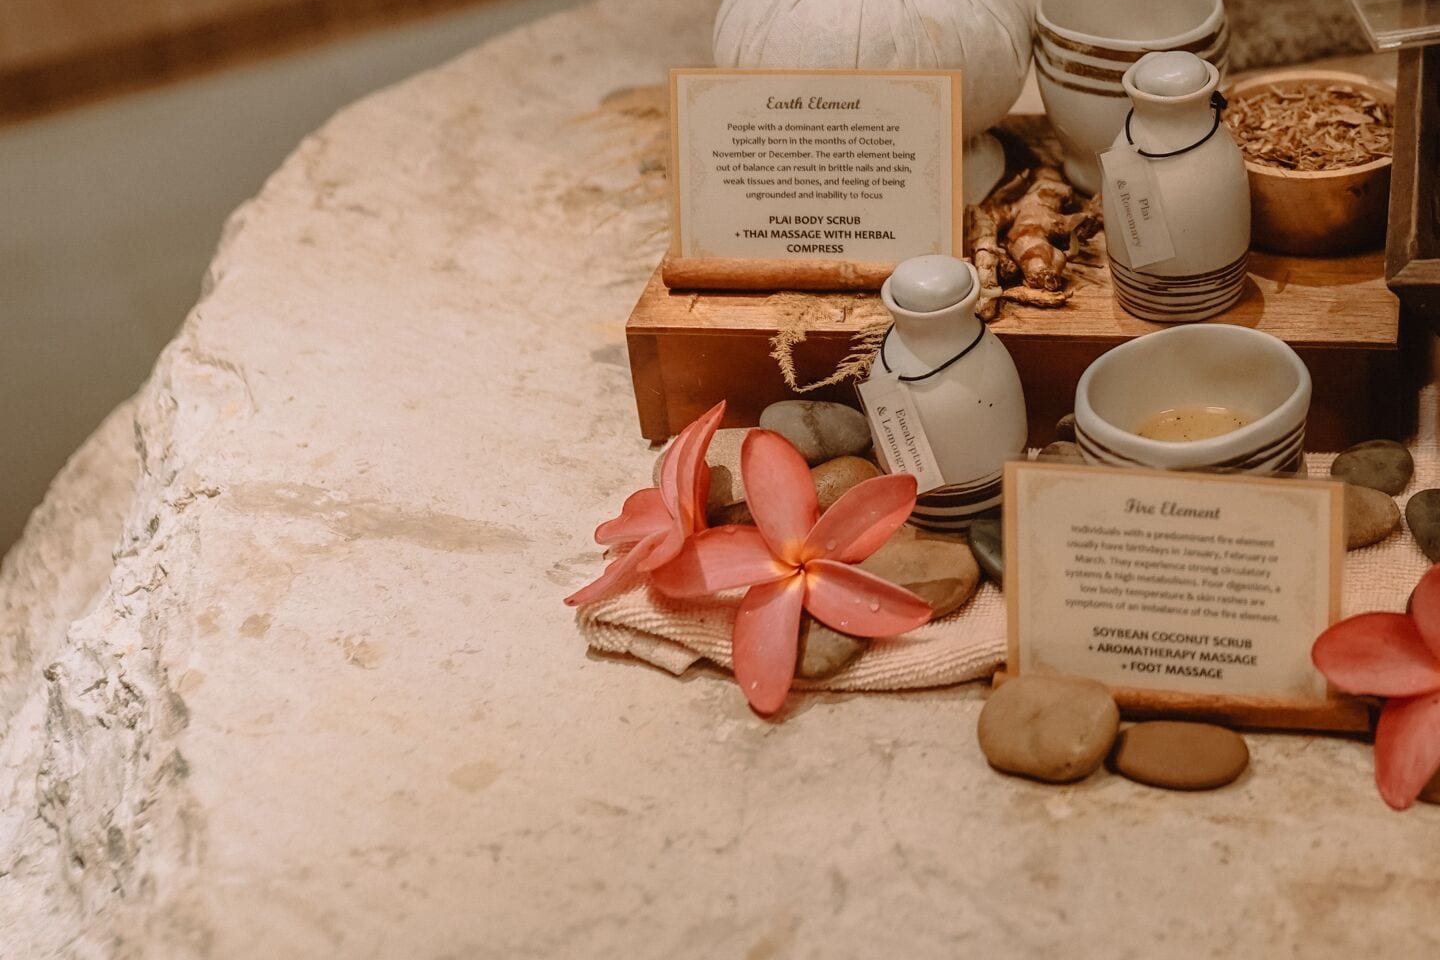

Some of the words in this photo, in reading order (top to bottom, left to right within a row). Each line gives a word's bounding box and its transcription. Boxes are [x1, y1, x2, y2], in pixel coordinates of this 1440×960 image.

[766, 97, 803, 110] Earth
[807, 97, 861, 110] Element
[727, 122, 756, 133] People
[757, 123, 776, 132] with
[777, 124, 783, 132] a
[784, 123, 825, 132] dominant
[826, 123, 849, 132] earth
[850, 123, 885, 132] element
[732, 136, 766, 147] typically
[767, 136, 788, 145] born
[789, 136, 797, 145] in
[799, 136, 813, 145] the
[814, 136, 847, 145] months
[847, 136, 857, 145] of
[858, 137, 896, 147] October,
[712, 150, 756, 158] November
[757, 151, 767, 159] or
[768, 150, 814, 159] December.
[815, 150, 831, 159] The
[832, 150, 855, 159] earth
[856, 150, 891, 159] element
[892, 150, 916, 161] being
[769, 215, 792, 225] PLAI
[794, 216, 824, 225] BODY
[826, 216, 861, 225] SCRUB
[1120, 193, 1142, 248] Rosemary
[742, 229, 768, 238] THAI
[770, 230, 822, 239] MASSAGE
[823, 230, 852, 239] WITH
[854, 230, 896, 240] HERBAL
[786, 244, 844, 253] COMPRESS
[877, 406, 888, 417] &
[895, 408, 925, 472] Eucalyptus
[1123, 498, 1156, 516] Fire
[1159, 501, 1221, 520] Element
[1092, 626, 1149, 641] SOYBEAN
[1151, 631, 1210, 646] COCONUT
[1213, 636, 1253, 650] SCRUB
[1096, 642, 1196, 661] AROMATHERAPY
[1199, 651, 1258, 666] MASSAGE
[1130, 661, 1162, 673] FOOT
[1164, 664, 1223, 680] MASSAGE
